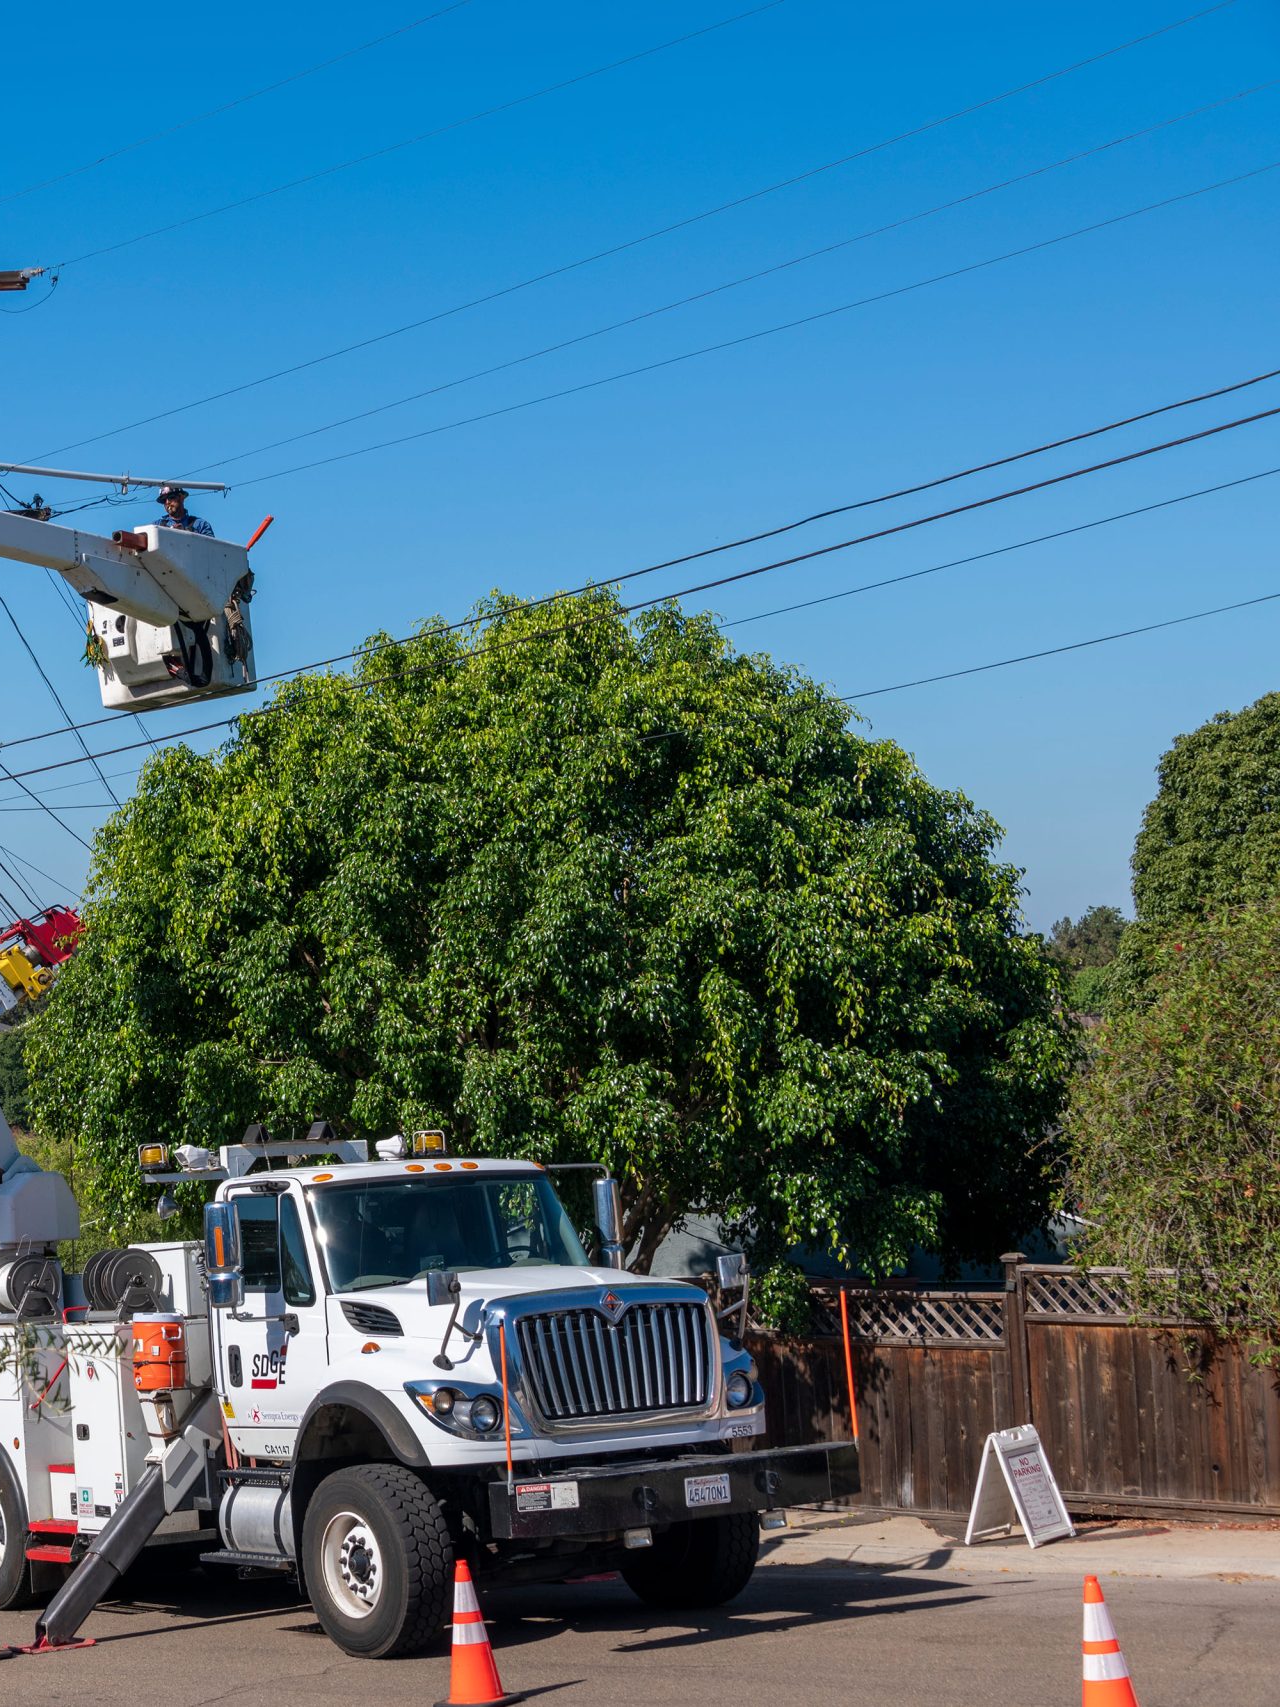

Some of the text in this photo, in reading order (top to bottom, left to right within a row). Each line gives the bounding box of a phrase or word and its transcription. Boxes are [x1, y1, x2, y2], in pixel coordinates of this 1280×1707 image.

[265, 1445, 290, 1455] CA1147
[1019, 1457, 1029, 1466] NO
[1013, 1464, 1041, 1478] PARKING
